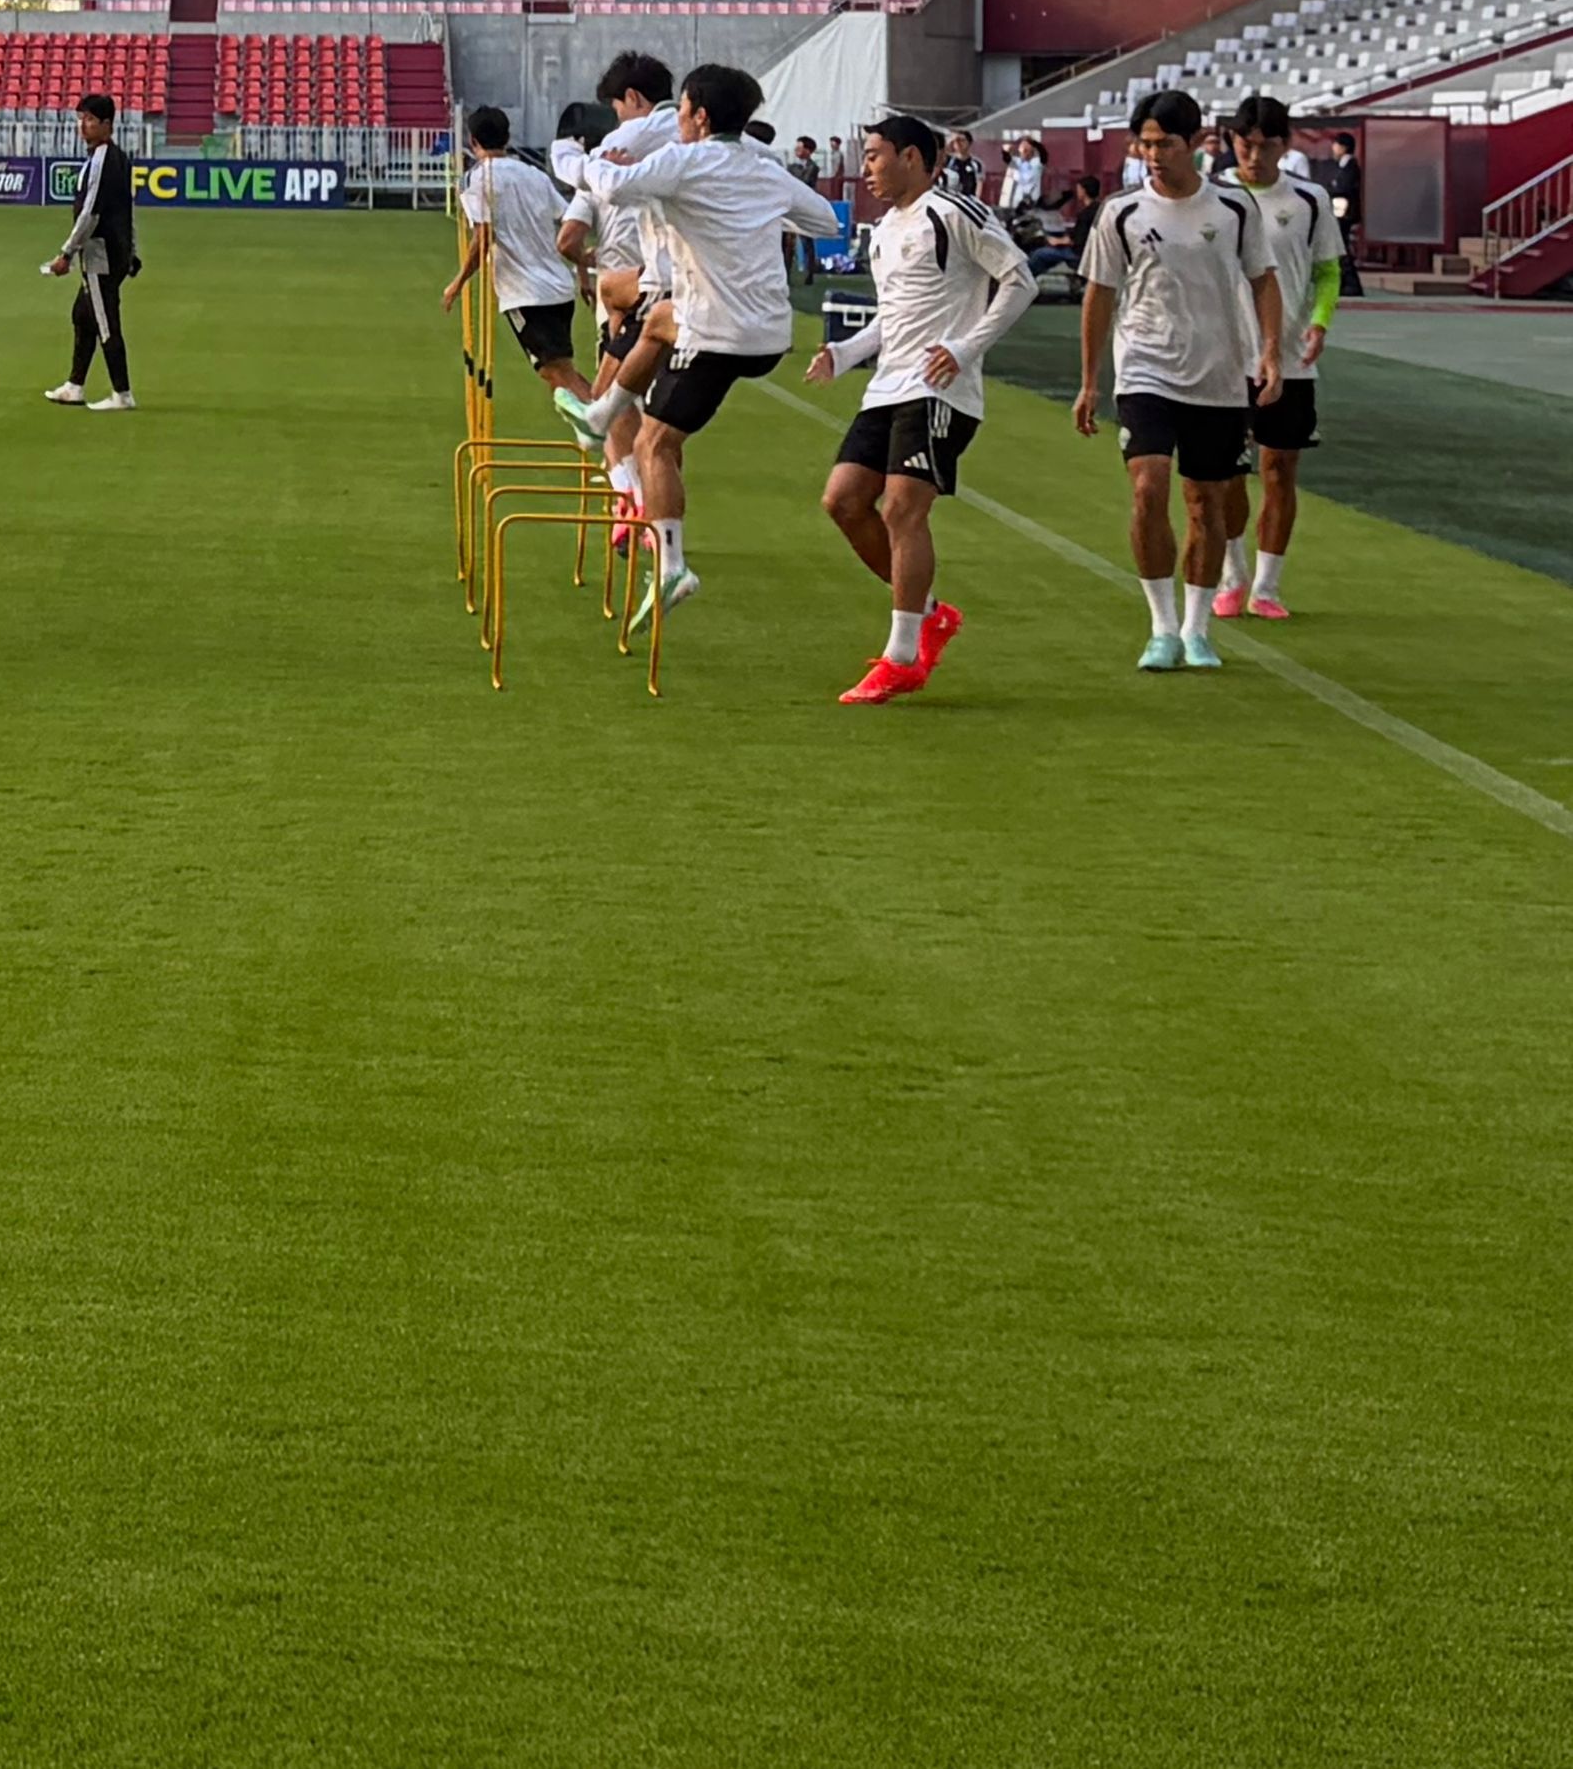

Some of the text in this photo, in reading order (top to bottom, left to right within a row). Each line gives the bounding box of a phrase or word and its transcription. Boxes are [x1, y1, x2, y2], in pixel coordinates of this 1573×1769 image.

[131, 166, 338, 202] FC LIVE APP
